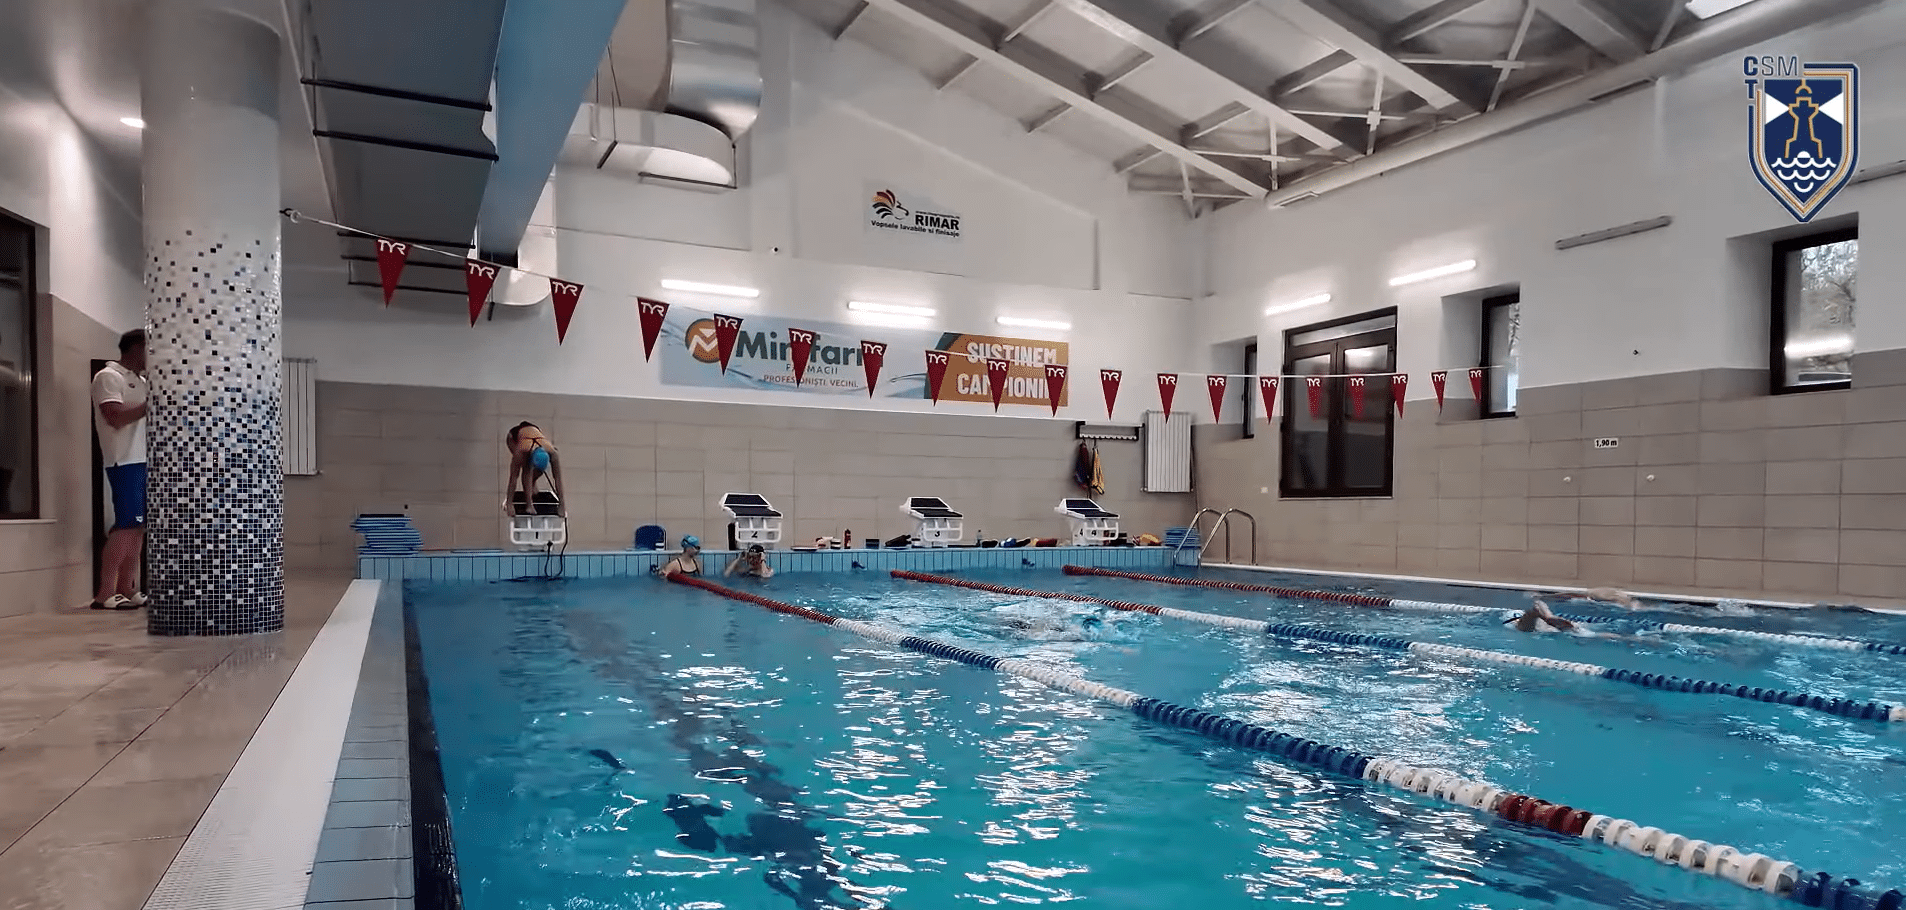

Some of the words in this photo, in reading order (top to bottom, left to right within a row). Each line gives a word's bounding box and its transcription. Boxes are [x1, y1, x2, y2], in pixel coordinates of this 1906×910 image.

[871, 220, 898, 230] Vopsele
[900, 223, 926, 233] lavabile
[915, 214, 960, 231] RIMAR
[378, 239, 406, 255] TYR
[468, 262, 495, 279] TYR
[552, 281, 578, 296] TYR
[640, 301, 665, 317] TYR
[716, 316, 737, 330] TYR
[791, 330, 812, 344] TYR
[863, 343, 883, 356] TYR
[928, 353, 947, 365] TYR
[786, 363, 838, 375] FMACII
[988, 360, 1007, 371] TYR
[1046, 367, 1065, 378] TYR
[1102, 371, 1119, 382] TYR
[1433, 373, 1446, 382] TYR
[1470, 369, 1482, 378] TYR
[1159, 375, 1176, 385] TYR
[1209, 377, 1224, 387] TYR
[1262, 378, 1277, 388] TYR
[1307, 378, 1320, 387] TYR
[1351, 378, 1365, 387] TYR
[1393, 375, 1407, 384] TYR
[1596, 439, 1610, 447] 1,90
[751, 530, 758, 538] 2
